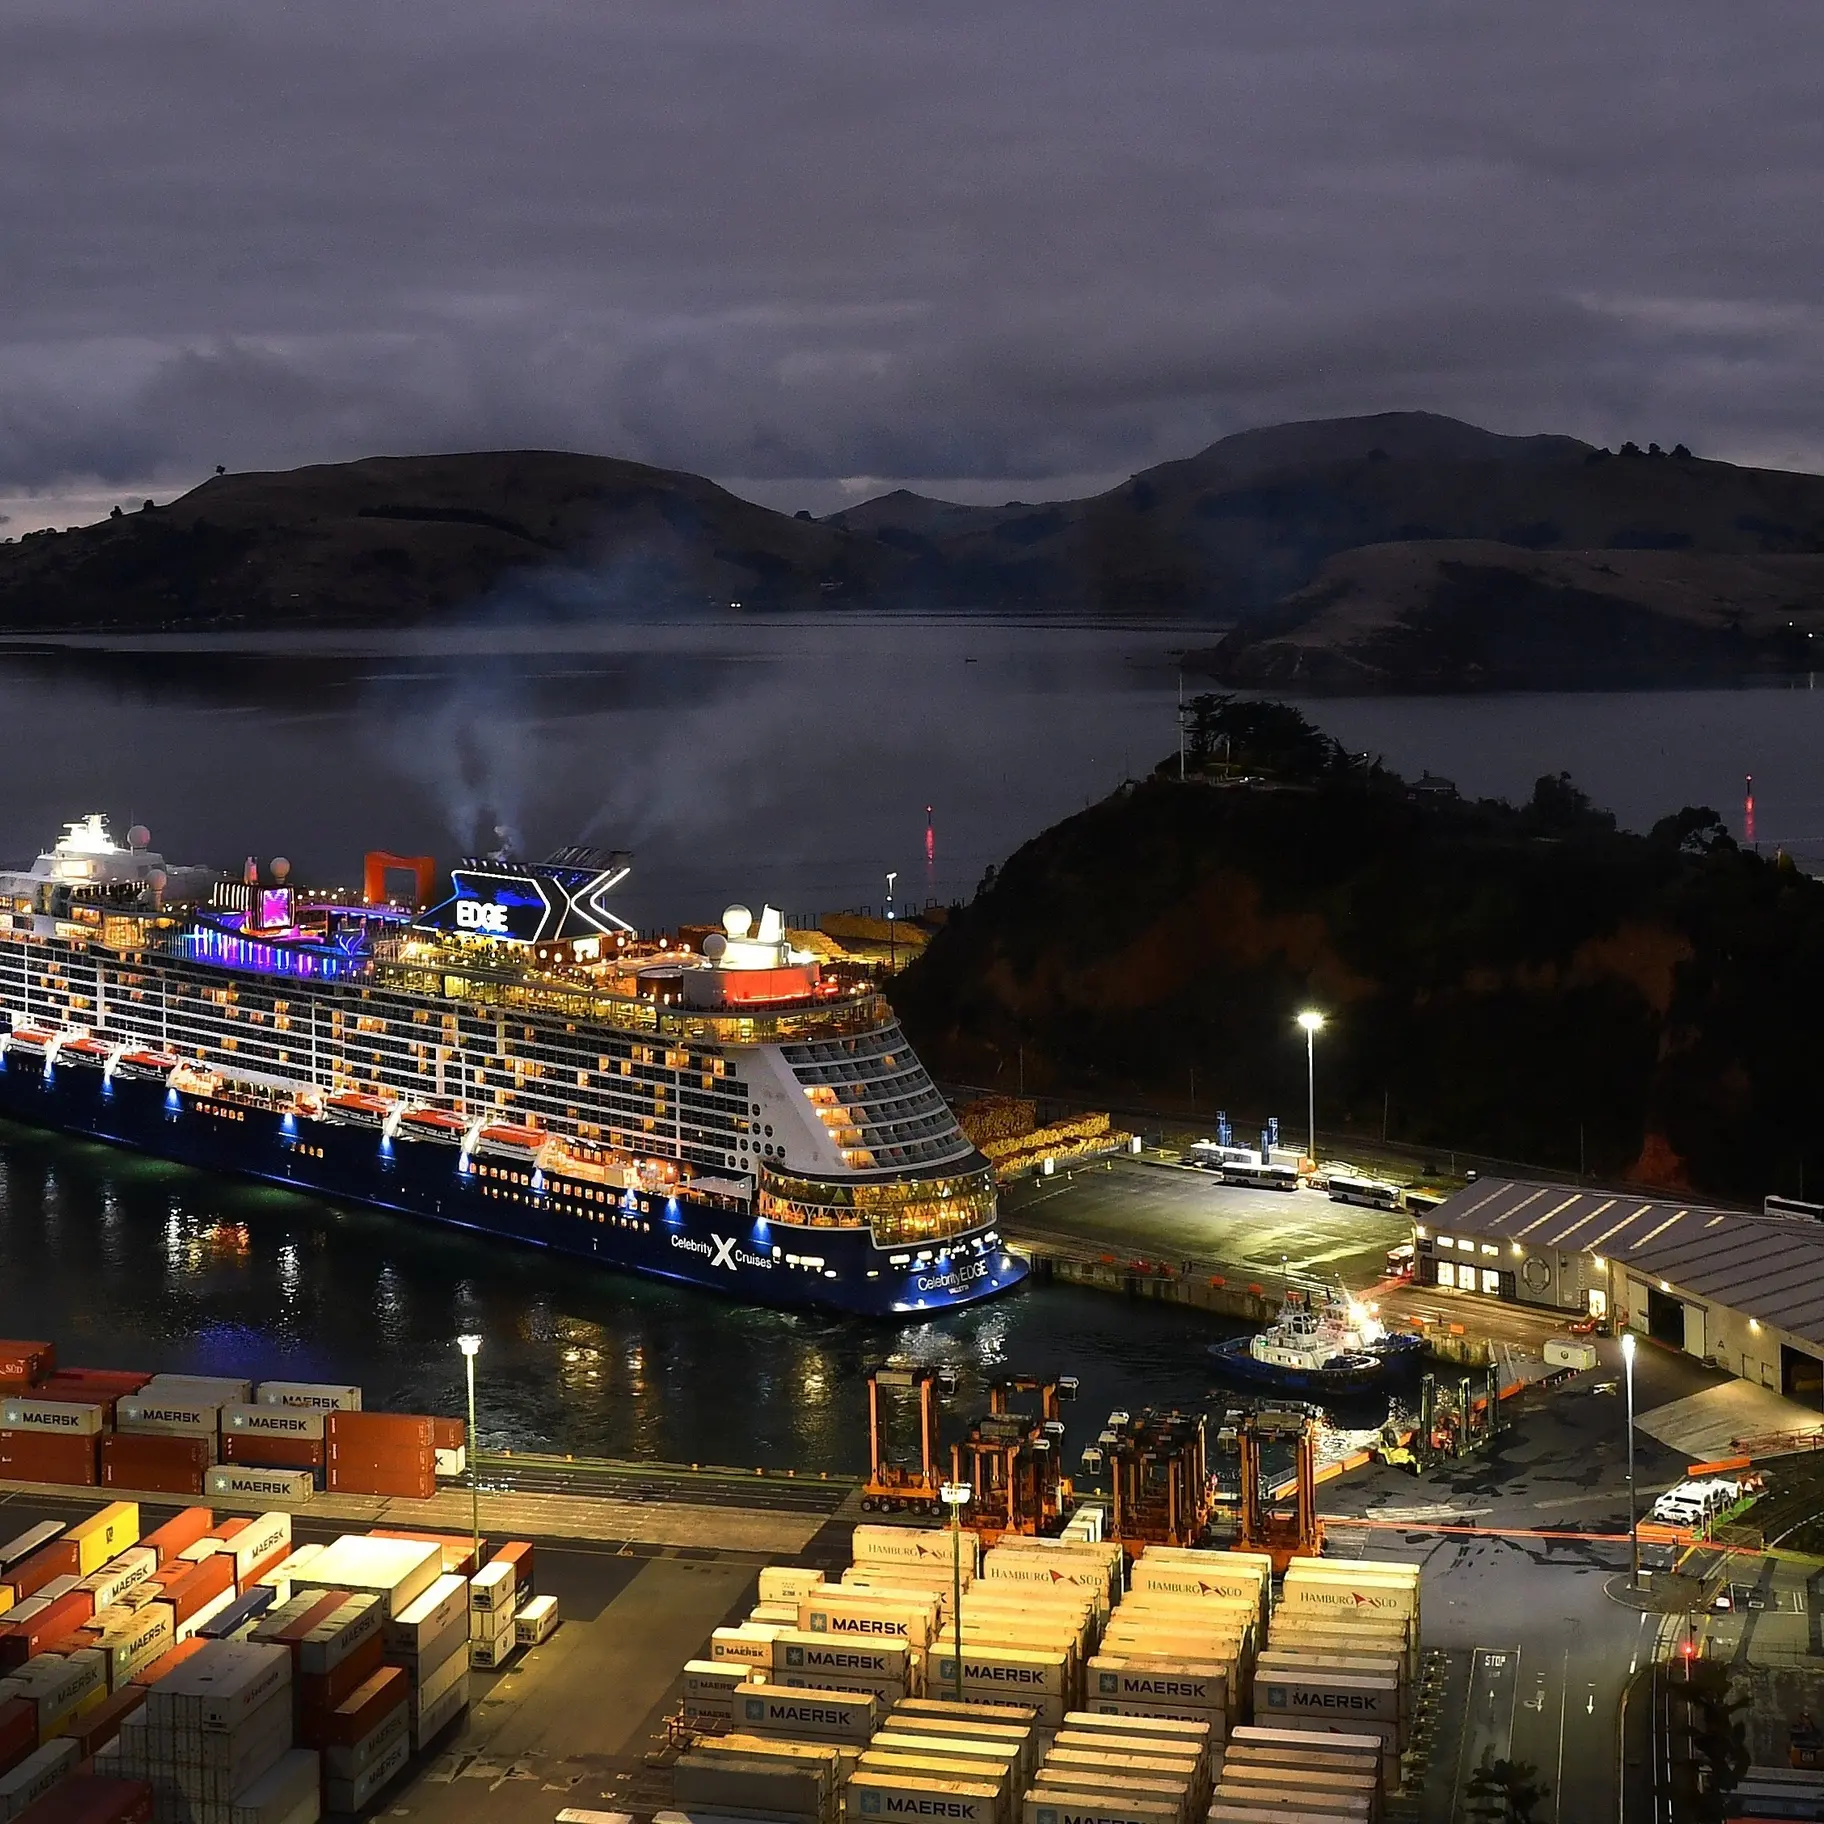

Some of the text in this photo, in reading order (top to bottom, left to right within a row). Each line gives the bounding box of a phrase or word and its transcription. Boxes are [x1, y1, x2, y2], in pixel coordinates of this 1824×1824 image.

[456, 900, 508, 932] EDGE
[671, 1234, 713, 1258] Celebrity
[735, 1249, 772, 1269] Cruises
[917, 1259, 989, 1291] Celebrity EDGE
[5, 1363, 24, 1374] SÜD
[282, 1395, 341, 1409] MAERSK
[22, 1411, 80, 1427] MAERSK
[143, 1408, 201, 1424] MAERSK
[248, 1416, 307, 1432] MAERSK
[231, 1479, 291, 1495] MAERSK
[251, 1526, 285, 1560] MAERSK
[868, 1543, 917, 1557] HAMBURG
[111, 1563, 149, 1599] MAERSK
[991, 1567, 1103, 1586] HAMBURG SÜD
[1147, 1579, 1243, 1598] HAMBURG SÜD
[1299, 1591, 1398, 1609] HAMBURG SÜD
[341, 1614, 376, 1648] MAERSK
[832, 1617, 908, 1636] MAERSK
[129, 1620, 168, 1656] MAERSK
[725, 1646, 765, 1658] MAERSK
[807, 1651, 885, 1671] MAERSK
[1484, 1654, 1507, 1667] STOP
[964, 1664, 1044, 1684] MAERSK
[57, 1668, 98, 1706] MAERSK
[1123, 1678, 1206, 1698] MAERSK
[1293, 1692, 1377, 1711] MAERSK
[699, 1710, 732, 1719] MAERS
[769, 1705, 851, 1726] MAERSK
[368, 1717, 402, 1752] MAERSK
[368, 1750, 402, 1785] MAERSK
[886, 1797, 976, 1819] MAERSK
